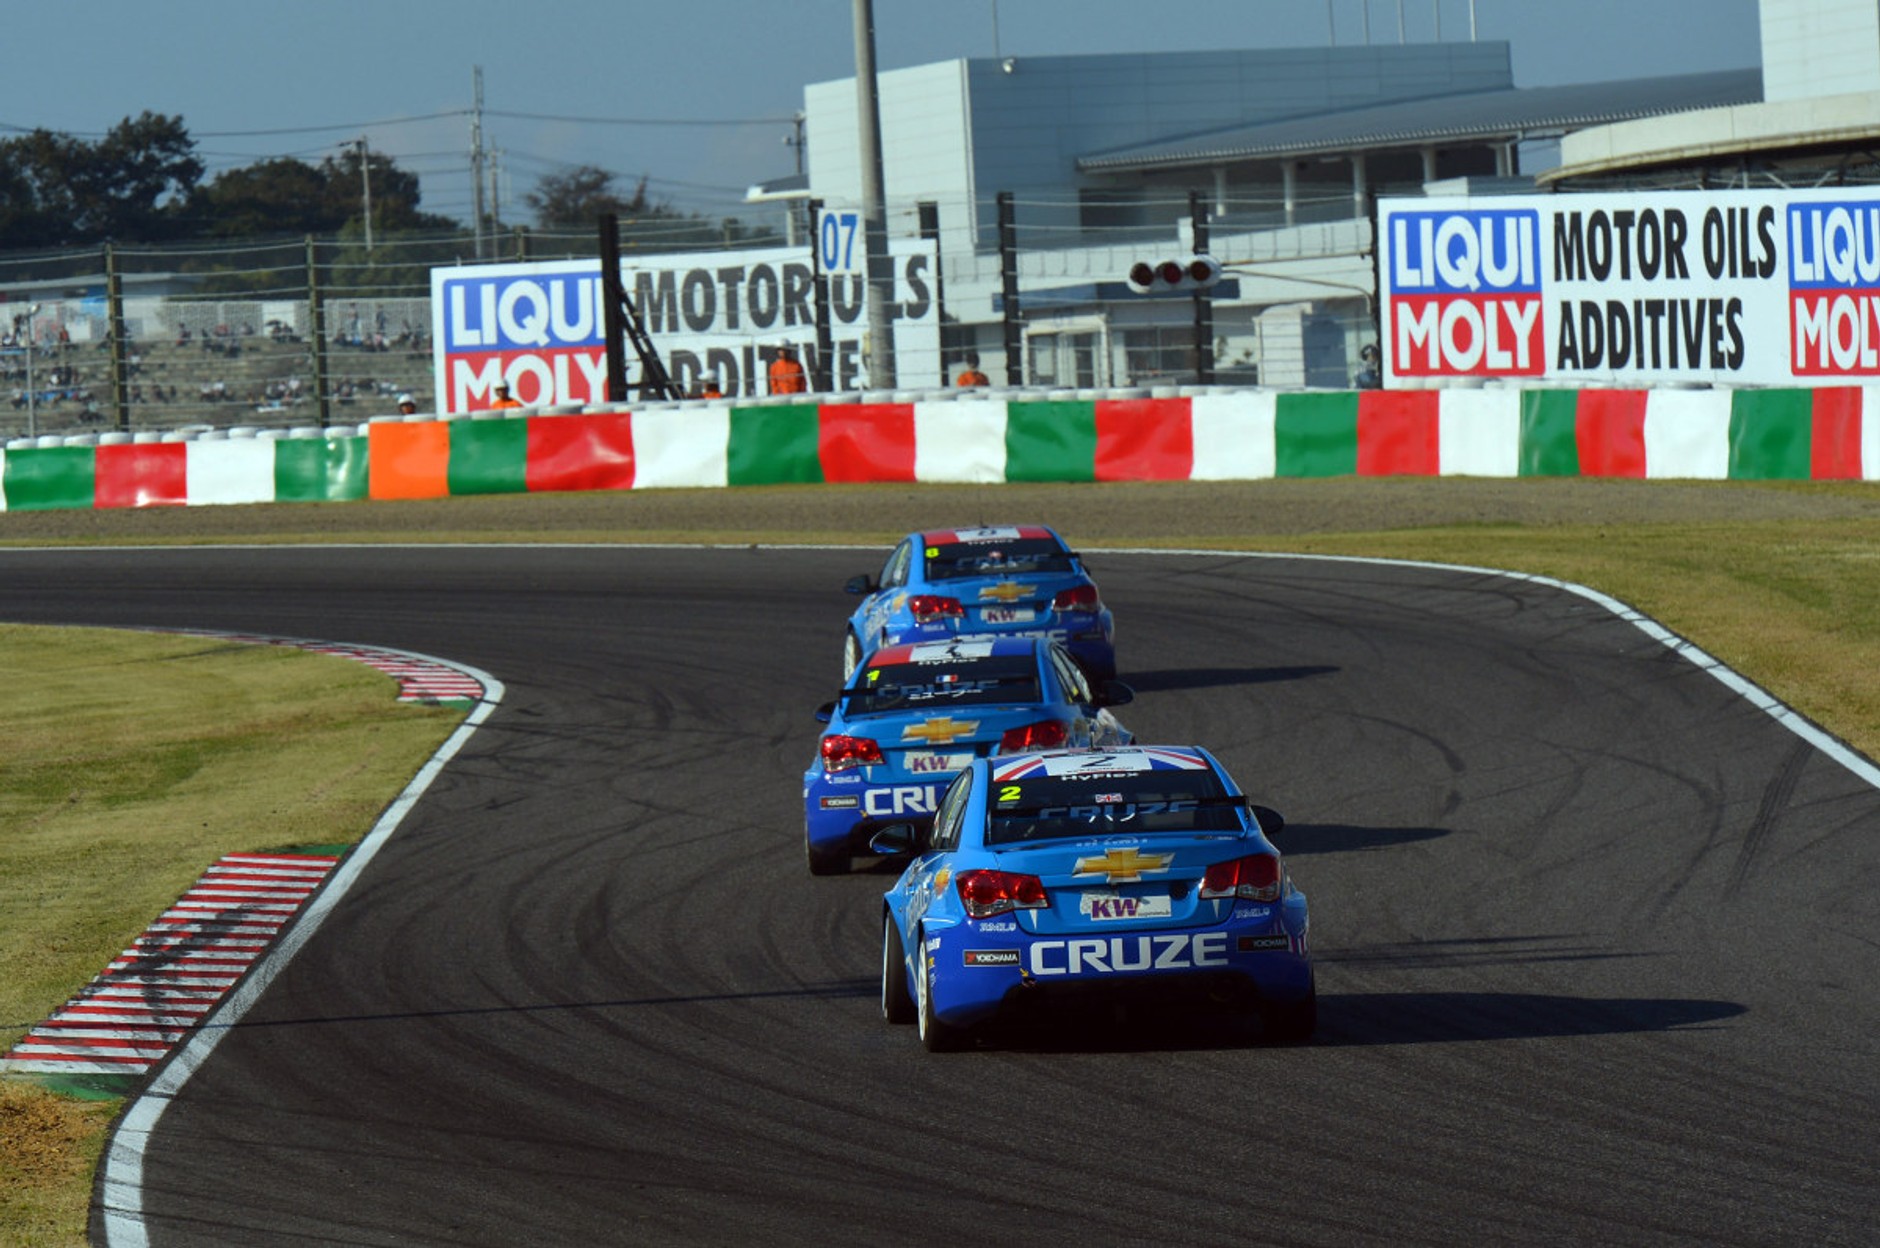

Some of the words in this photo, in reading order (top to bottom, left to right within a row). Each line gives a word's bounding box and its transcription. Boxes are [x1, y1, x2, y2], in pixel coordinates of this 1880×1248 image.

[822, 213, 858, 270] 07
[1394, 215, 1535, 292] LIQUI
[1553, 209, 1690, 282] MOTOR
[1702, 204, 1777, 280] OILS
[451, 279, 606, 346] LIQUI
[635, 262, 815, 333] MOTOR
[1397, 298, 1541, 371] MOLY
[1557, 297, 1745, 371] ADDITIVES
[453, 353, 608, 414] MOLY
[988, 610, 1017, 622] KW
[867, 670, 880, 681] 1
[913, 757, 950, 771] KW
[999, 786, 1021, 800] 2
[1092, 898, 1138, 918] KW
[1030, 932, 1228, 975] CRUZE
